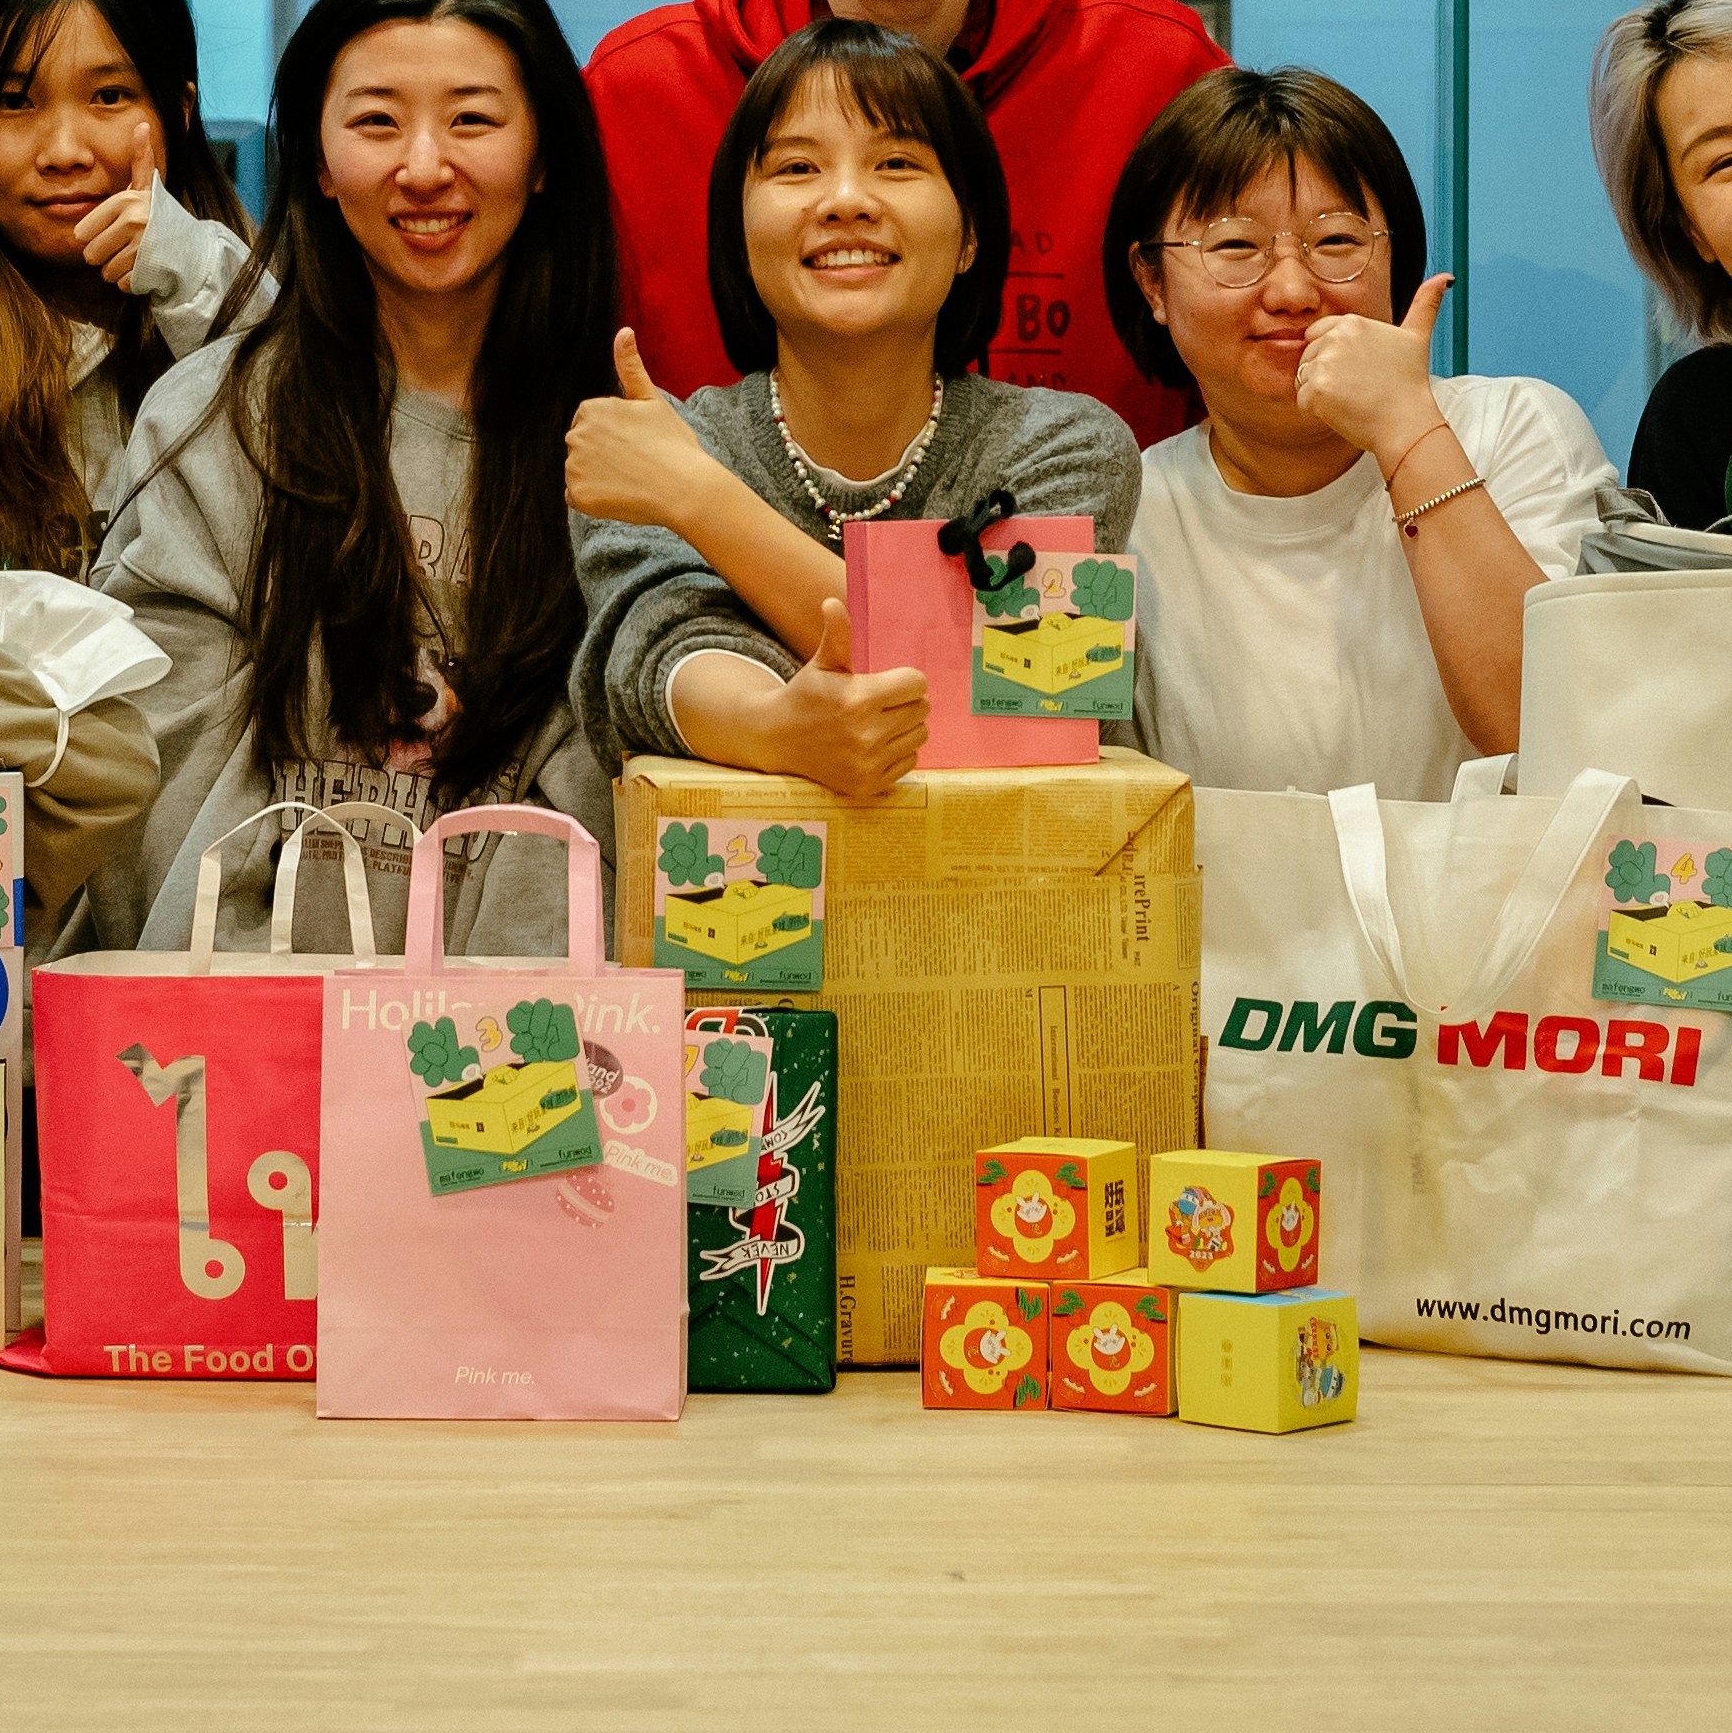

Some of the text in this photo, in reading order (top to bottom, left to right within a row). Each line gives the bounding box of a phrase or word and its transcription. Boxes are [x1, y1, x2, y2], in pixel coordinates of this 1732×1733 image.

[1670, 852, 1698, 884] 4
[575, 992, 661, 1034] ink.
[1218, 997, 1418, 1059] DMG
[1437, 1005, 1702, 1087] MORI
[755, 1182, 780, 1202] STO
[1416, 1297, 1691, 1340] www.dmgmori.com
[104, 1343, 172, 1373] The
[184, 1343, 274, 1373] Food
[454, 1366, 535, 1385] Pink me.
